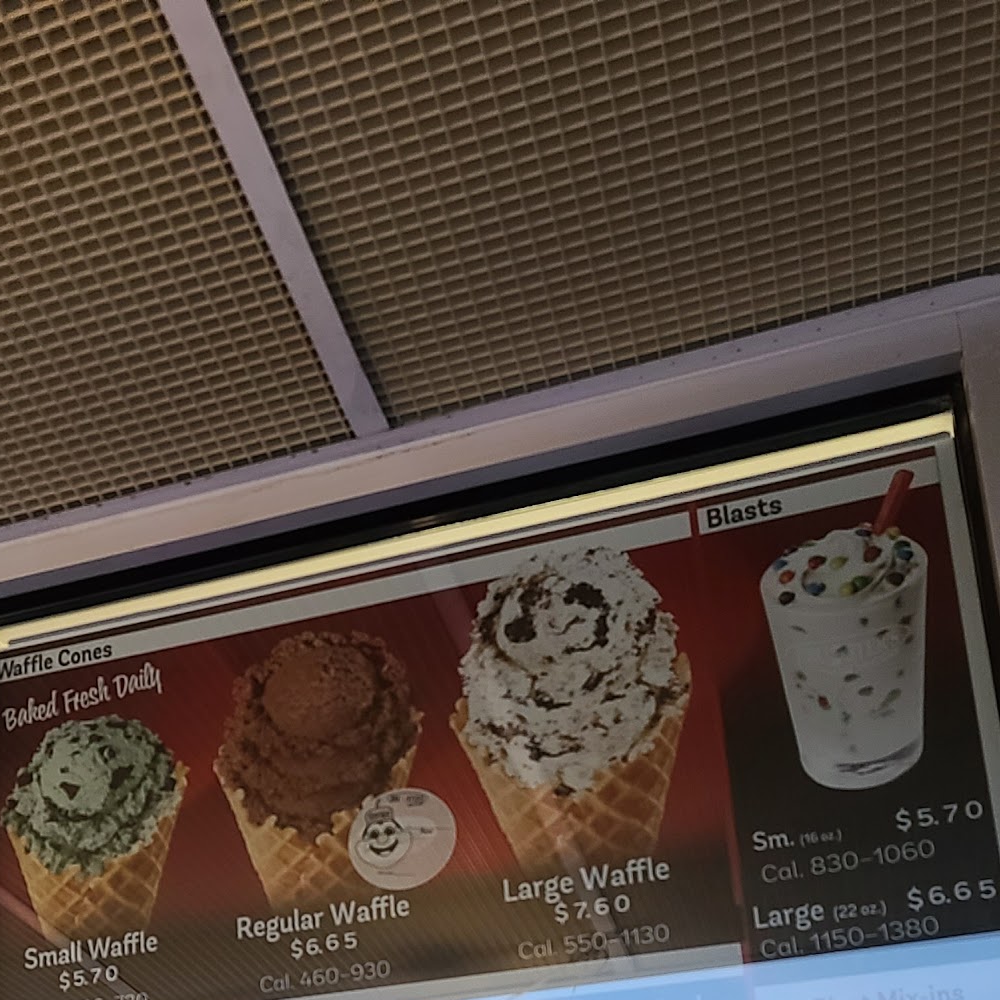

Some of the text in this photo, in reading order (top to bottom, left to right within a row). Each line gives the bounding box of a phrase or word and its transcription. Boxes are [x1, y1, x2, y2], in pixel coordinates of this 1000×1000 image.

[707, 498, 783, 529] Blasts
[58, 644, 113, 667] Cones
[2, 662, 163, 731] Baked Fresh Daily
[895, 800, 983, 832] $5.70
[752, 831, 795, 852] Sm.
[761, 839, 936, 884] Cal. 830-1060
[502, 857, 671, 904] Large Waffle
[907, 879, 997, 912] $6.65
[236, 895, 411, 943] Regular Waffle
[553, 894, 631, 925] $7.60
[752, 901, 887, 931] Large (22 oz.)
[24, 932, 159, 971] Small Waffle
[290, 931, 358, 960] $6.65
[517, 923, 671, 961] Cal. 550-1130
[760, 916, 940, 960] Cal. 1150-1380
[59, 965, 119, 992] $5.70
[259, 960, 391, 993] Cal. 460-930
